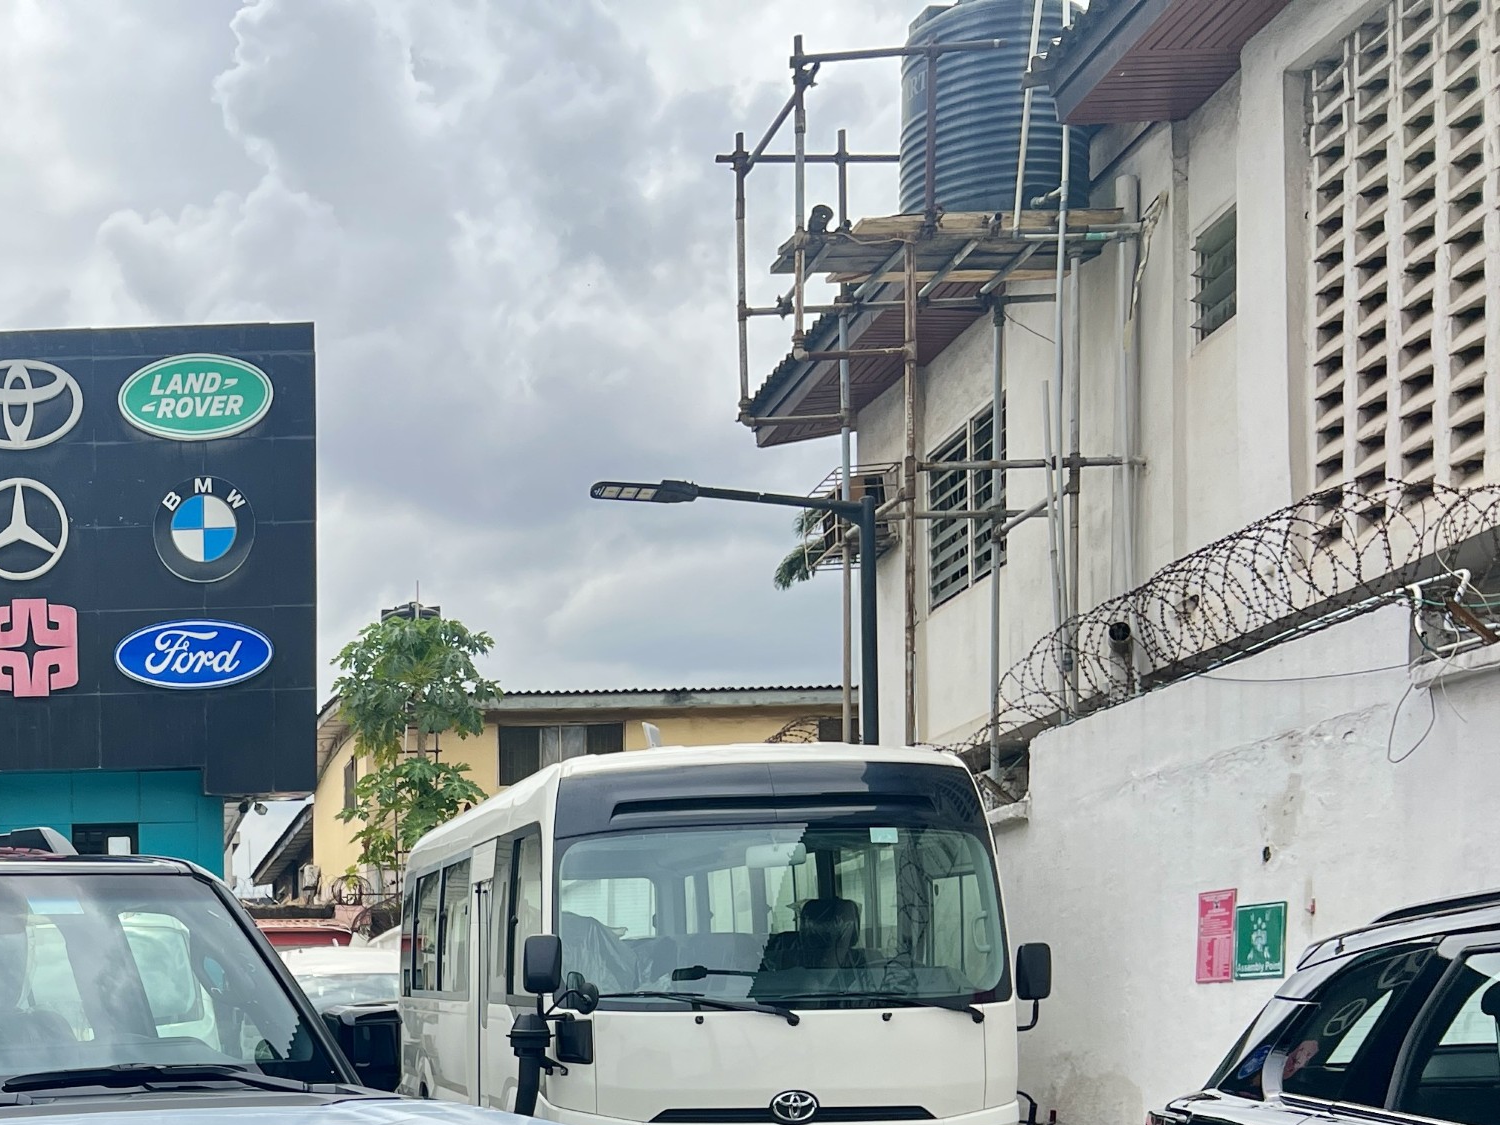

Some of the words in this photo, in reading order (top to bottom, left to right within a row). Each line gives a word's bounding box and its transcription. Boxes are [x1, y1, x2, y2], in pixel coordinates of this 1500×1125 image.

[163, 477, 246, 512] BMW
[145, 630, 242, 675] Ford
[1237, 962, 1264, 973] Assembly
